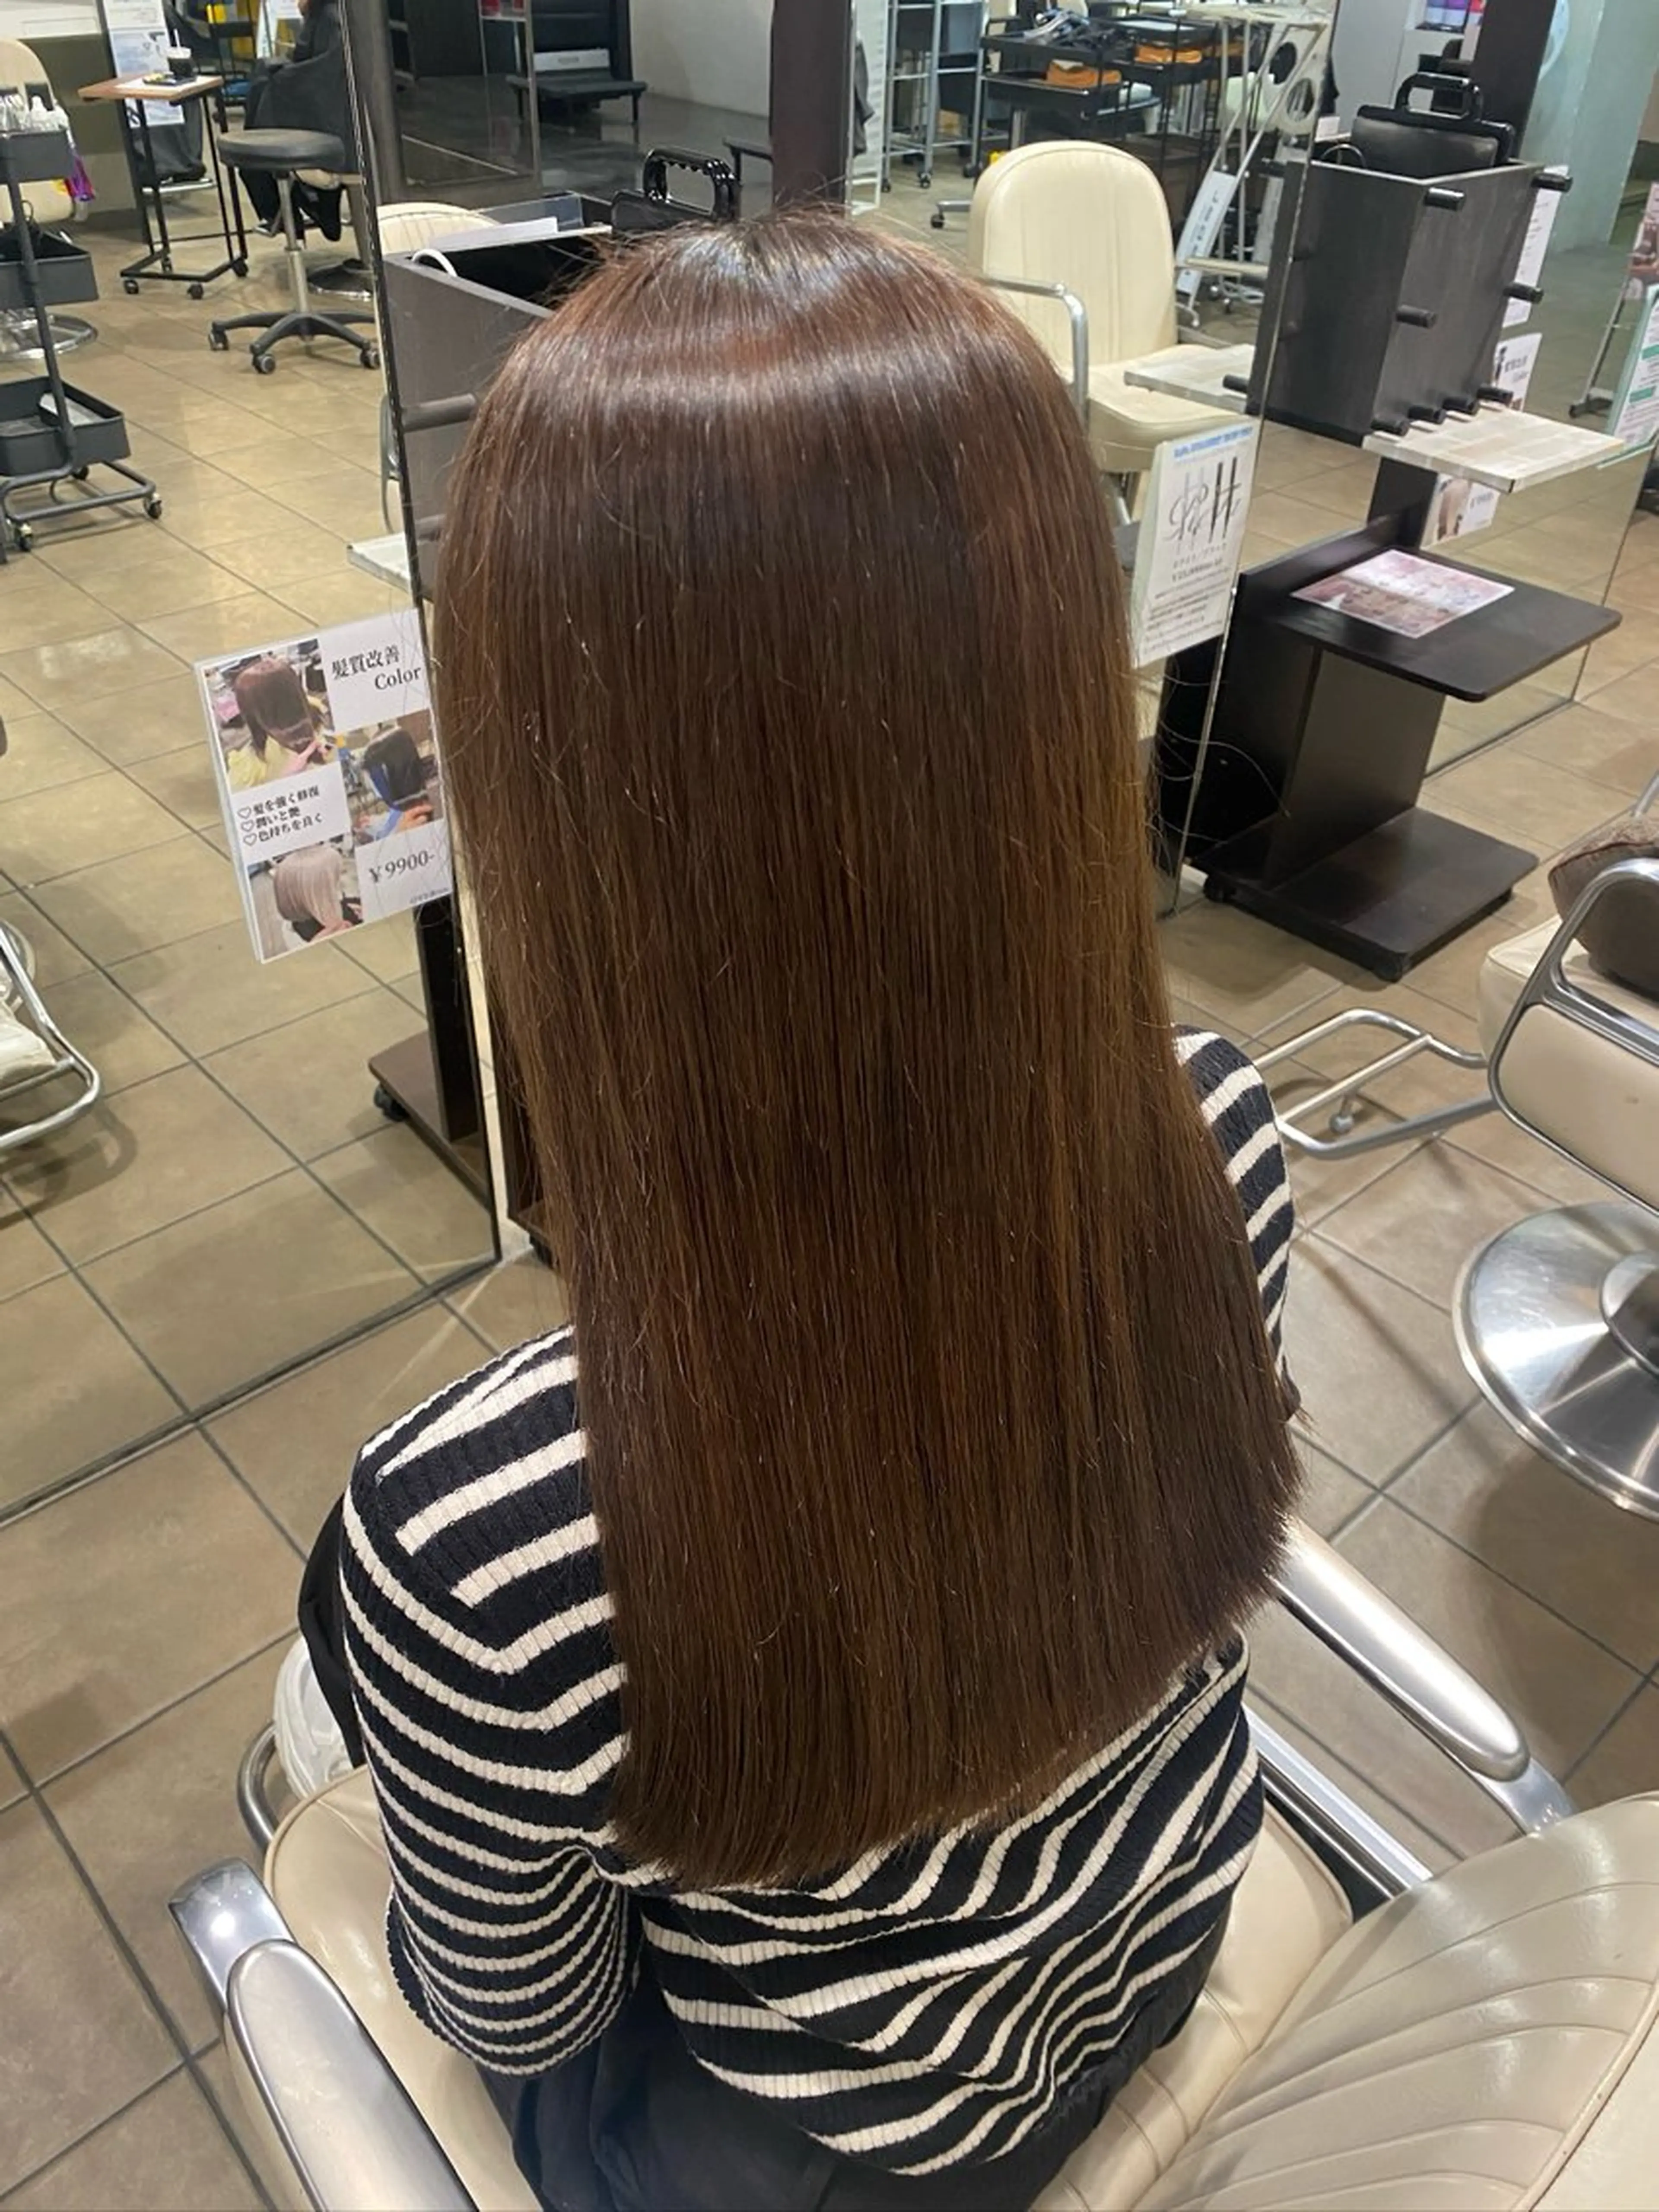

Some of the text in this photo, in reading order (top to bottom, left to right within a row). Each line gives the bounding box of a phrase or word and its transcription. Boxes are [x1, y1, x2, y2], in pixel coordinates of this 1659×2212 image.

[332, 644, 400, 680] 髪質改善
[374, 667, 422, 690] Color
